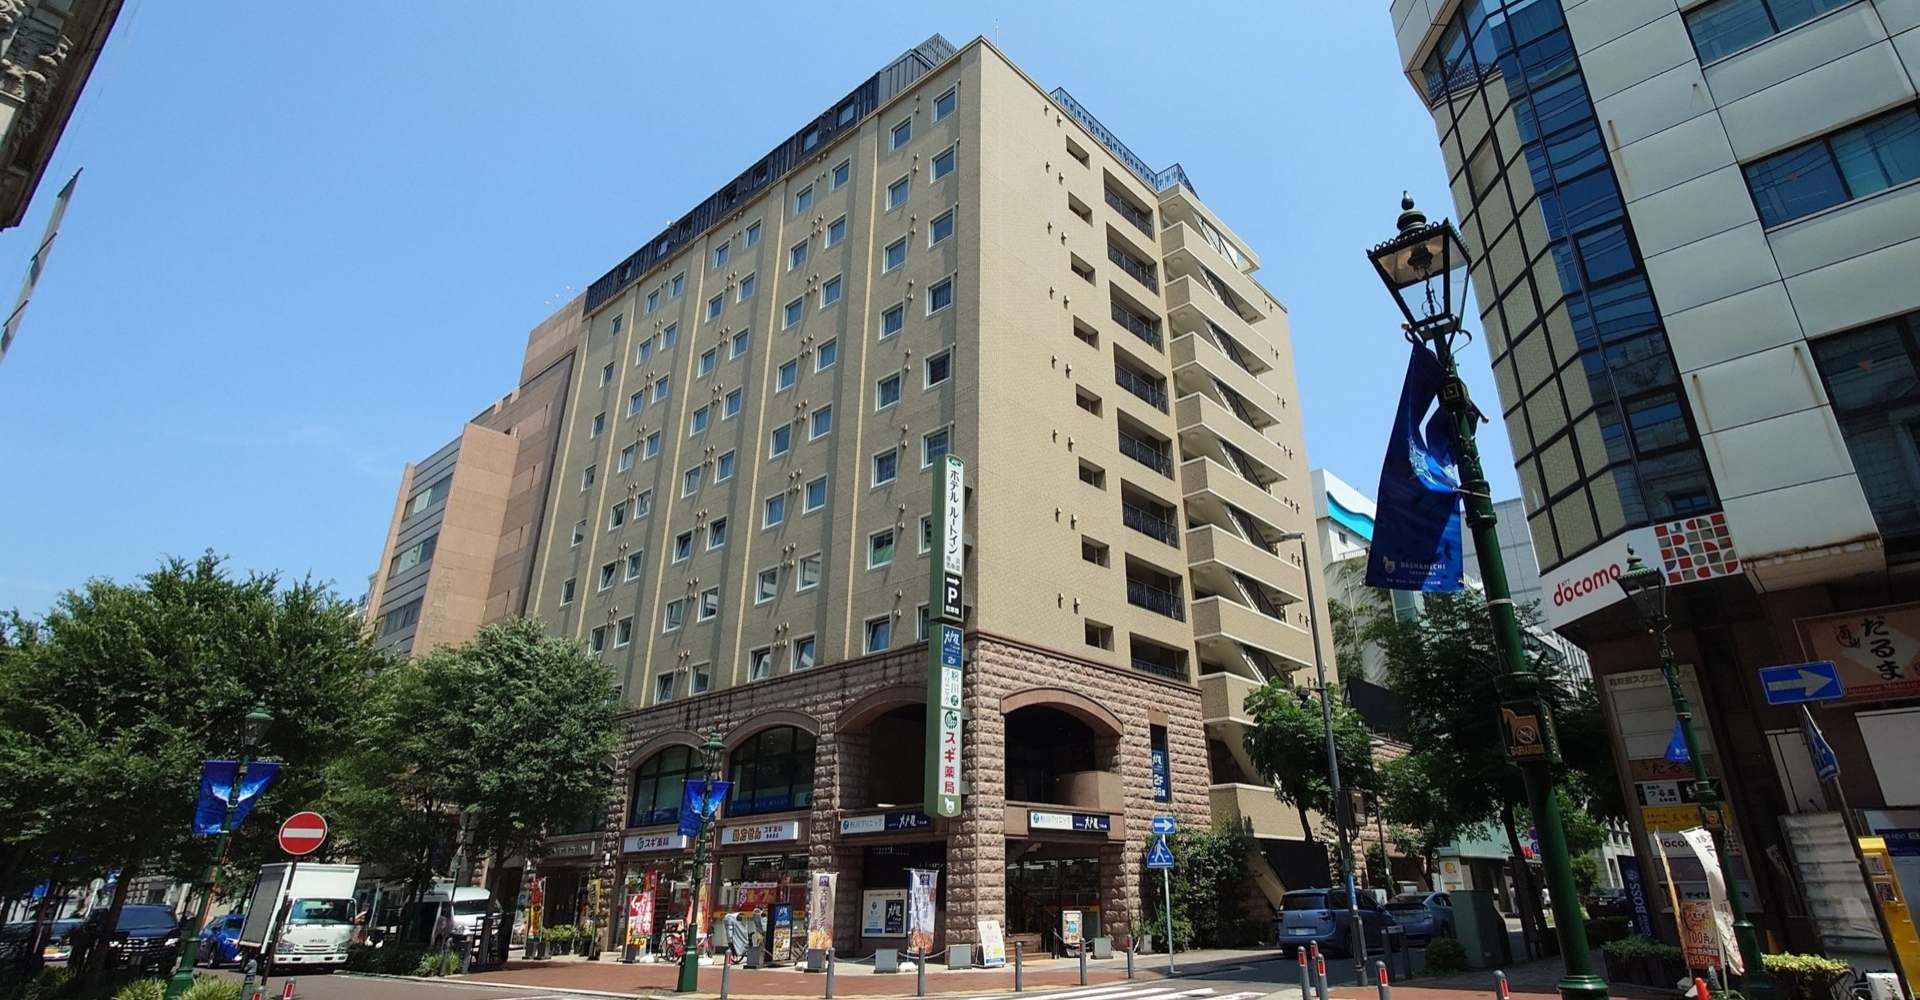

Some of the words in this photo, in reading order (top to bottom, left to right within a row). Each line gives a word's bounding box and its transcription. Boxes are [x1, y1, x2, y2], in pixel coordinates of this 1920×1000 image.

[1554, 564, 1620, 607] docomo
[1561, 578, 1570, 587] NTT
[948, 586, 958, 604] P
[1861, 616, 1905, 680] だるま
[948, 656, 956, 664] 2F
[1884, 682, 1917, 690] Modern
[944, 730, 956, 794] スギ薬局
[1154, 774, 1164, 786] 2F
[1648, 788, 1676, 797] つる屋
[732, 828, 762, 842] 処方せん
[645, 837, 669, 848] スギ薬局
[1630, 883, 1646, 913] BOSS
